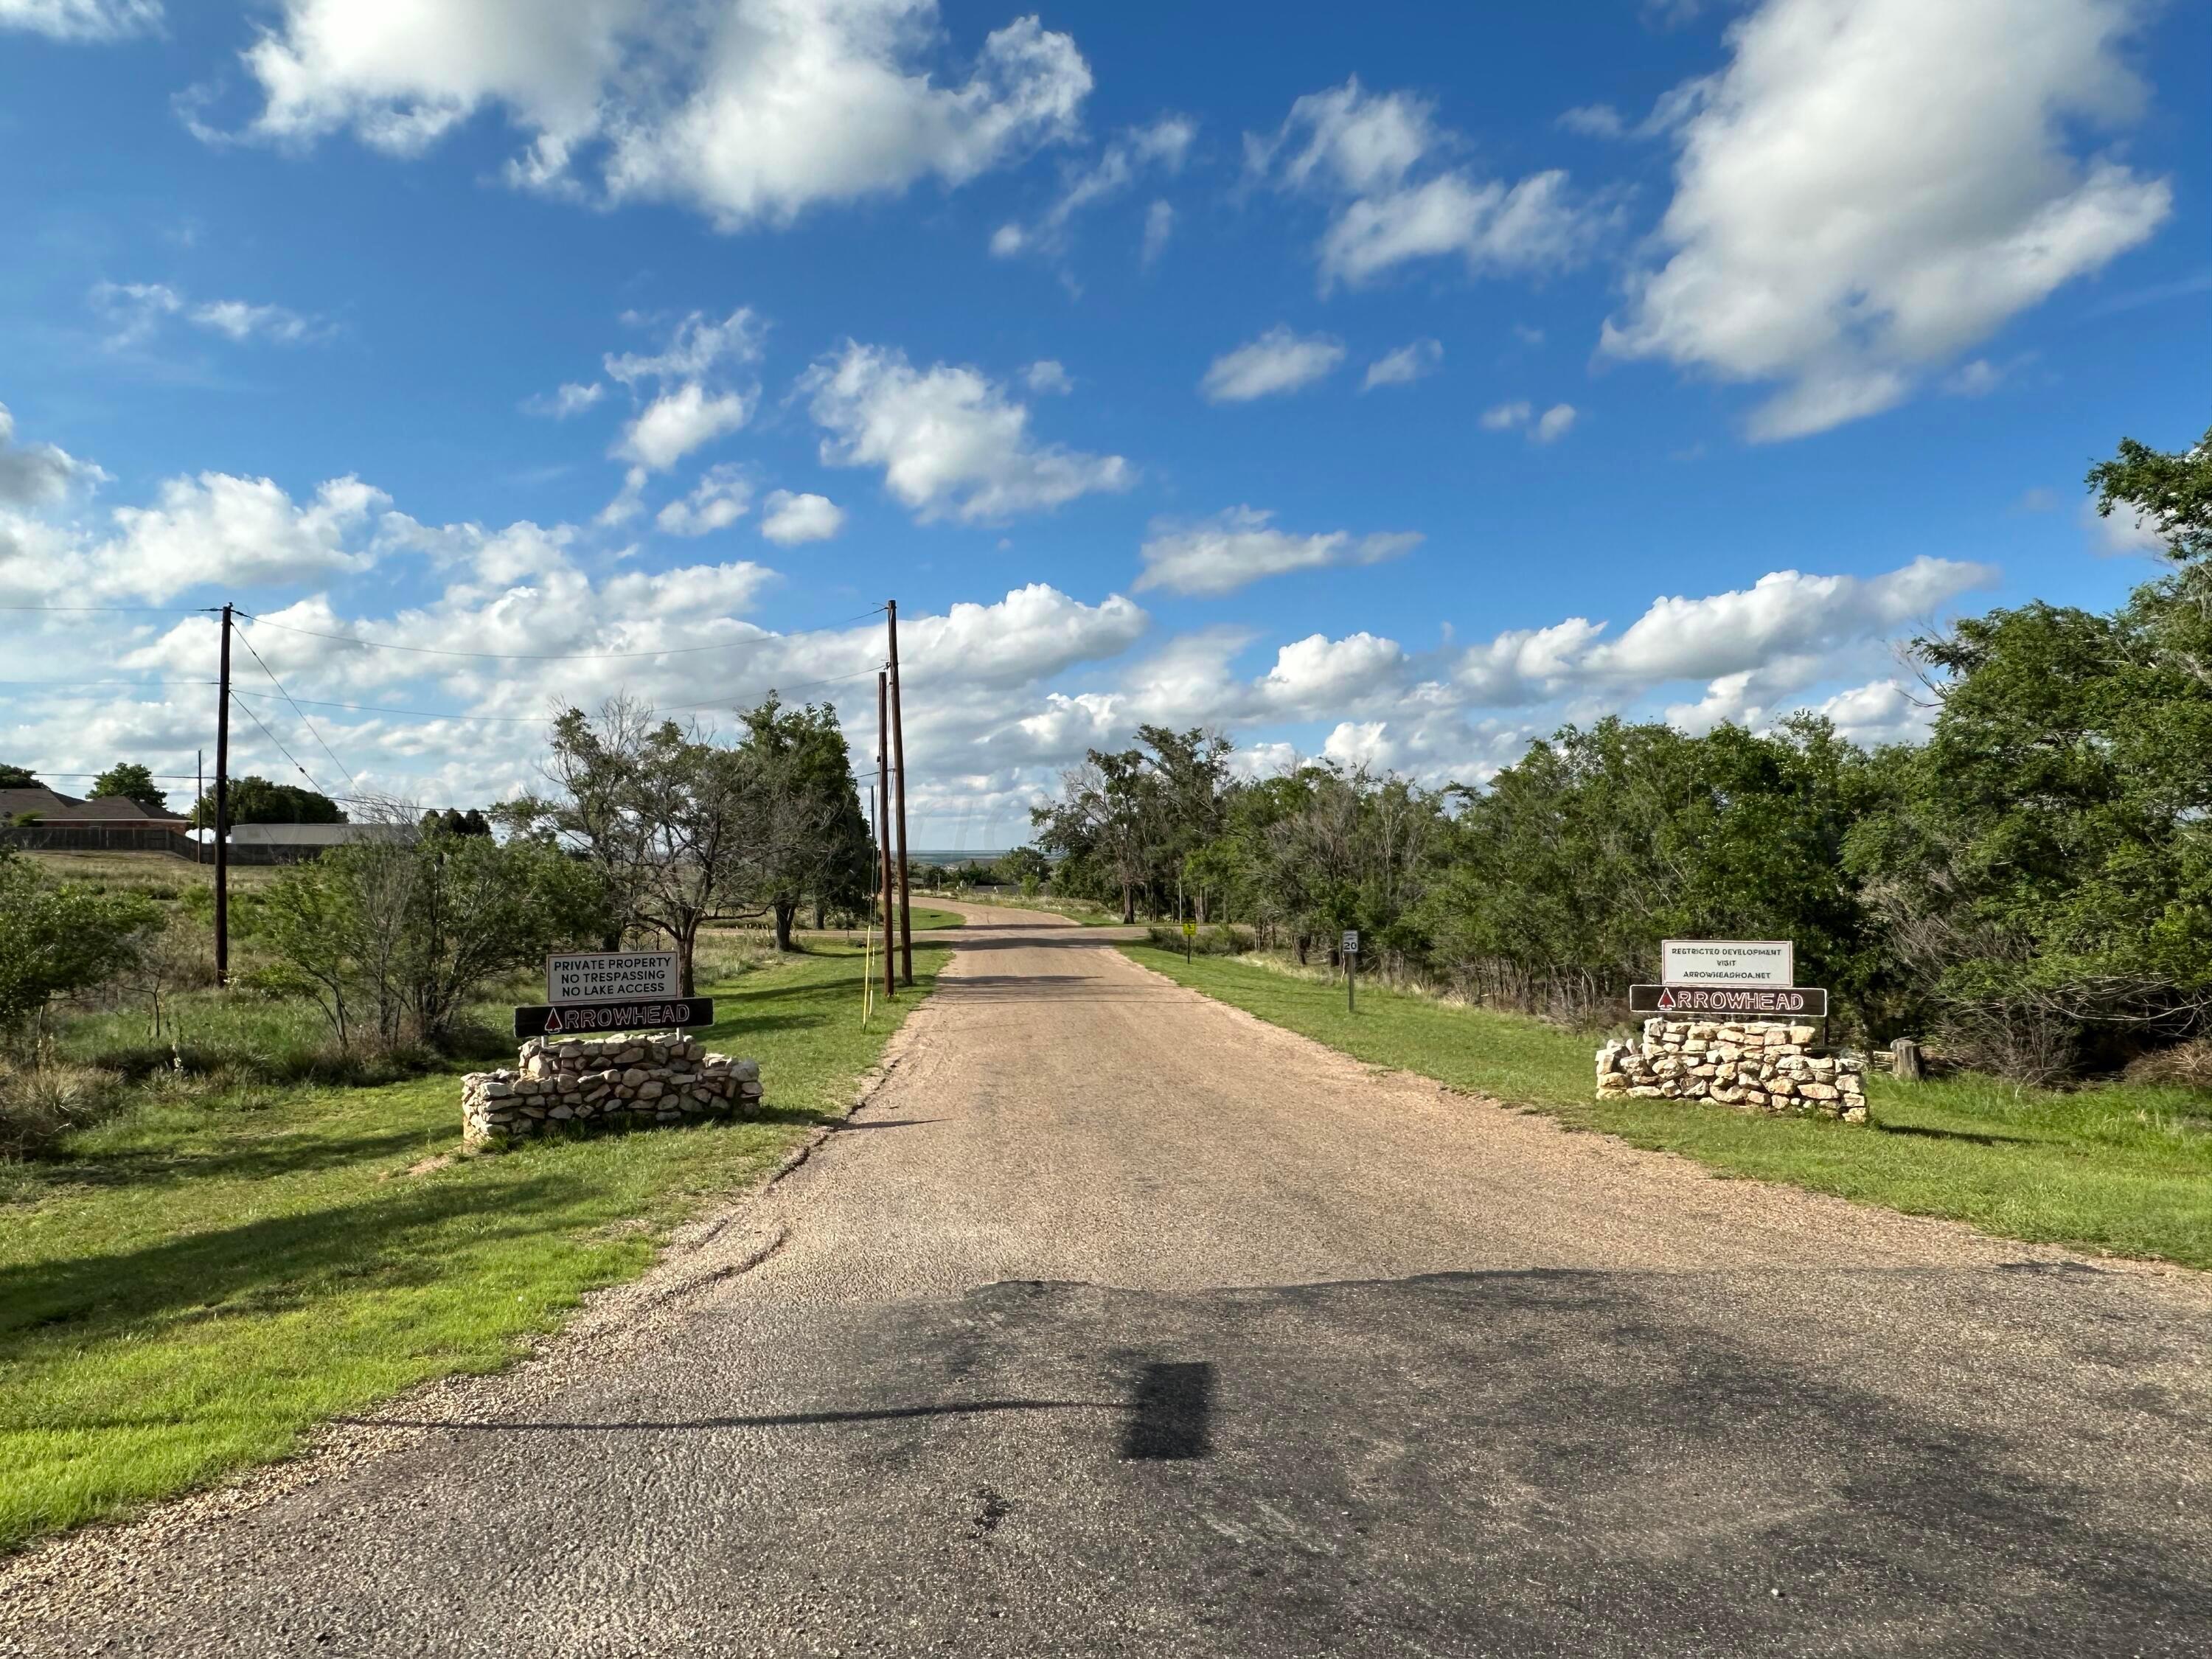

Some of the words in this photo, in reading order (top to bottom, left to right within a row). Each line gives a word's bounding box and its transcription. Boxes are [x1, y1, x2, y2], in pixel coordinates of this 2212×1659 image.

[1343, 942, 1357, 950] 20
[1671, 947, 1719, 956] RESTRICTED
[1722, 948, 1782, 956] DEVELOPMENT
[554, 959, 605, 972] PRIVATE
[608, 957, 672, 969] PROPERTY
[561, 973, 579, 984] NO
[583, 970, 666, 983] TRESPASSING
[562, 987, 580, 997] NO
[584, 984, 614, 995] LAKE
[617, 982, 665, 994] ACCESS
